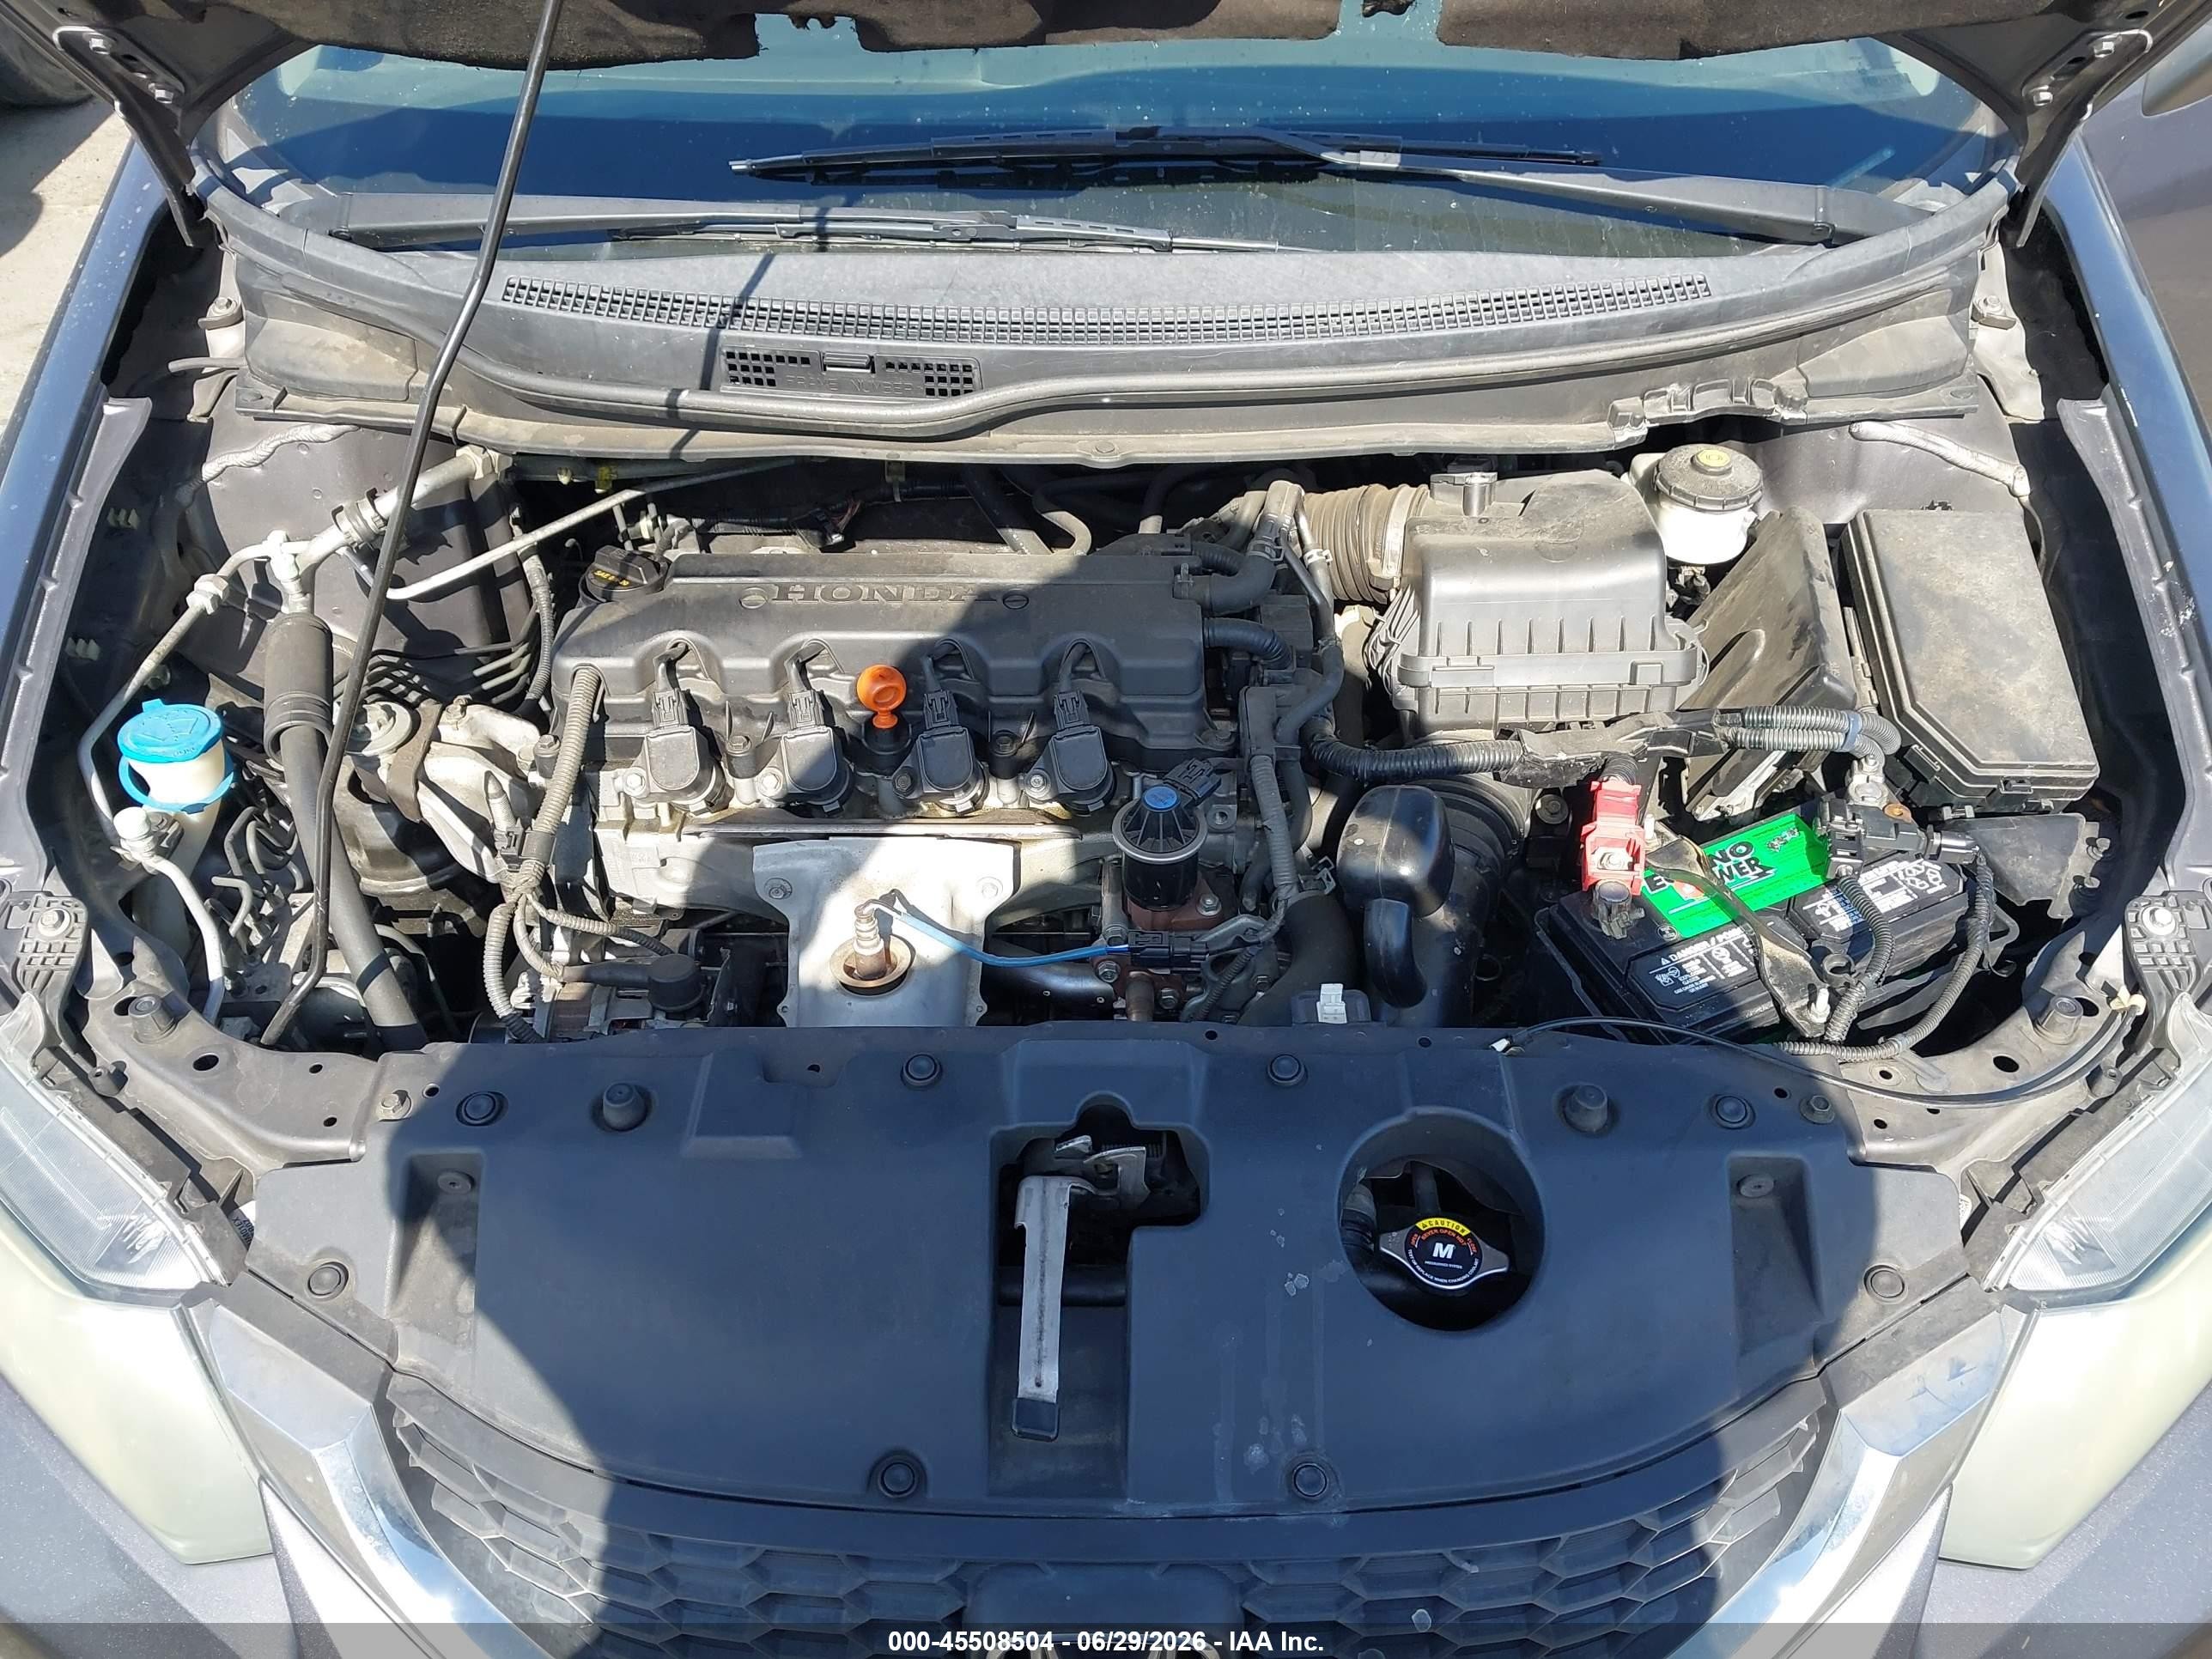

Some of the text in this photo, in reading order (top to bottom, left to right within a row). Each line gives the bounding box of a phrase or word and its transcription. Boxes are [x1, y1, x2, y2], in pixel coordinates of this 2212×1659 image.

[785, 374, 915, 395] FRAME NUMBER
[772, 583, 997, 604] HONDA
[1420, 1228, 1439, 1241] NEVER
[1439, 1228, 1456, 1237] OPEN
[1428, 1219, 1467, 1235] CAUTION
[1432, 1243, 1455, 1259] M
[1416, 1265, 1434, 1279] REPLACE
[1448, 1273, 1470, 1283] CHANGING
[1468, 1257, 1480, 1275] COOLANT
